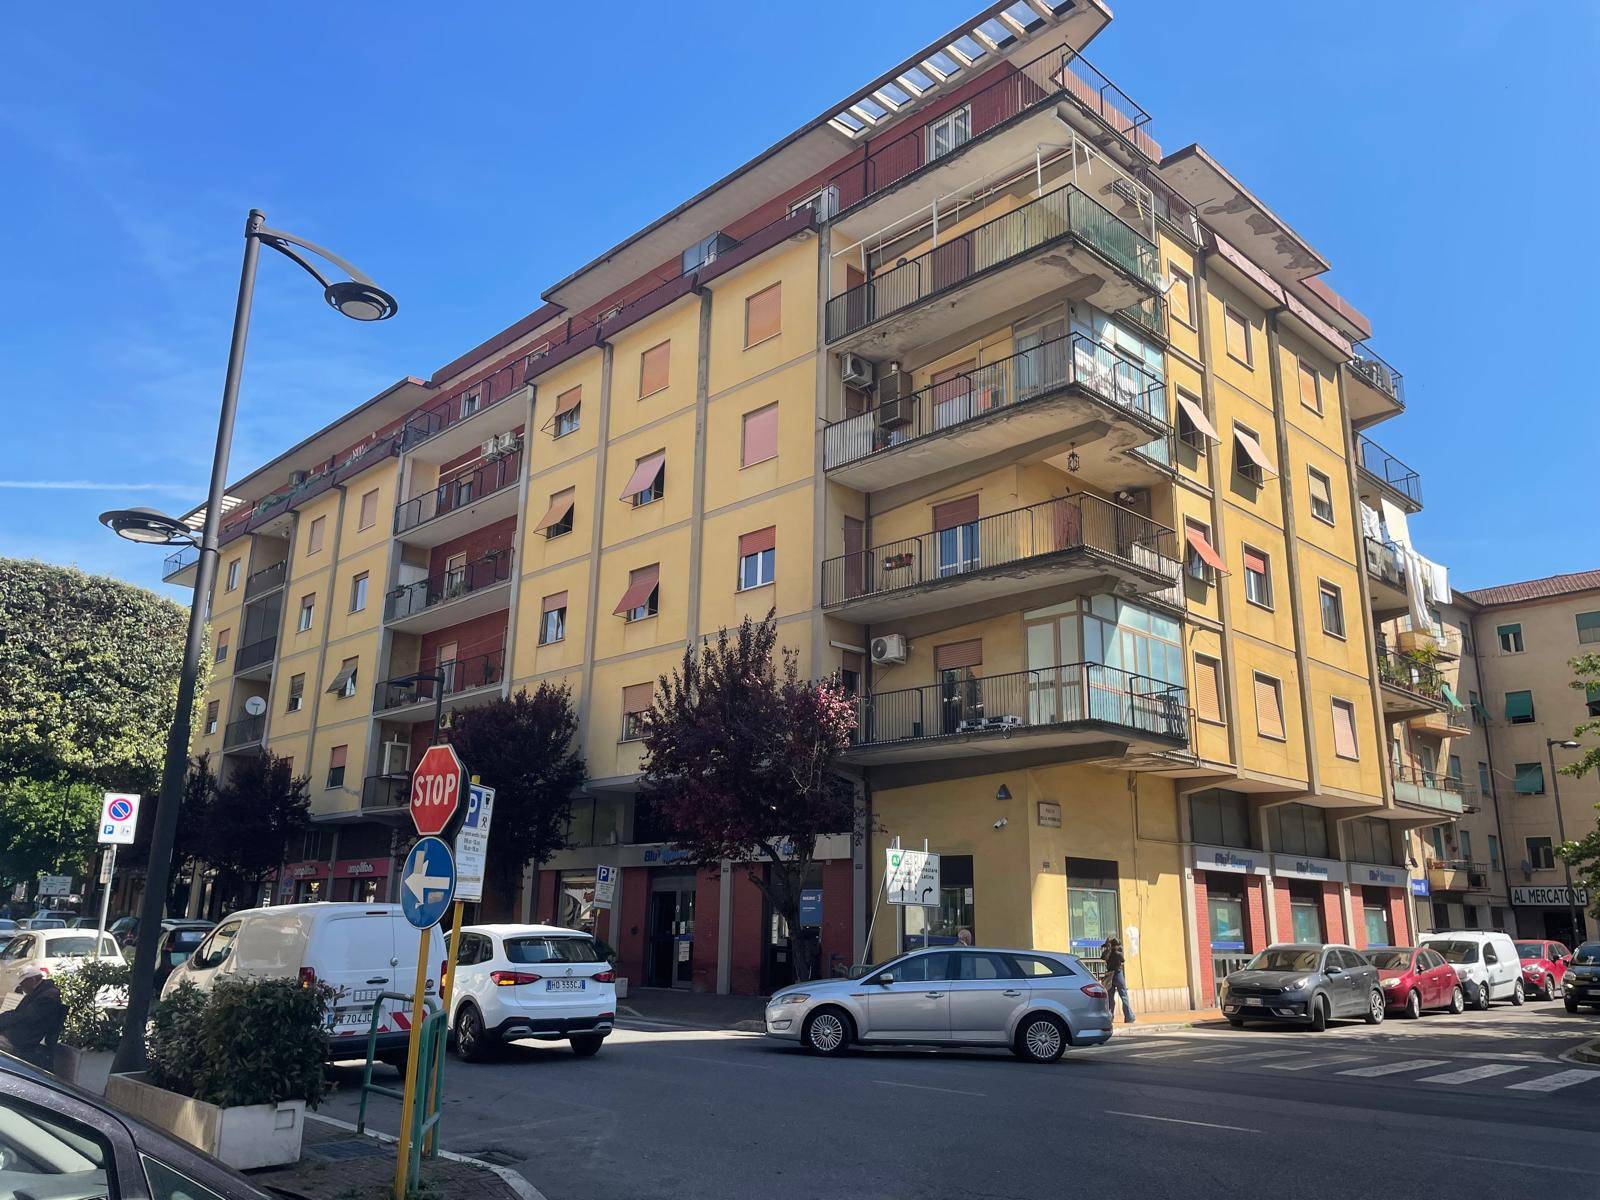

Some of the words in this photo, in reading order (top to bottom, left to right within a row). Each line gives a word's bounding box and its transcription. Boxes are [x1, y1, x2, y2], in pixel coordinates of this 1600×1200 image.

[414, 773, 456, 807] STOP
[465, 792, 478, 823] P
[105, 826, 113, 834] P
[600, 868, 608, 880] P
[1514, 888, 1526, 904] AL
